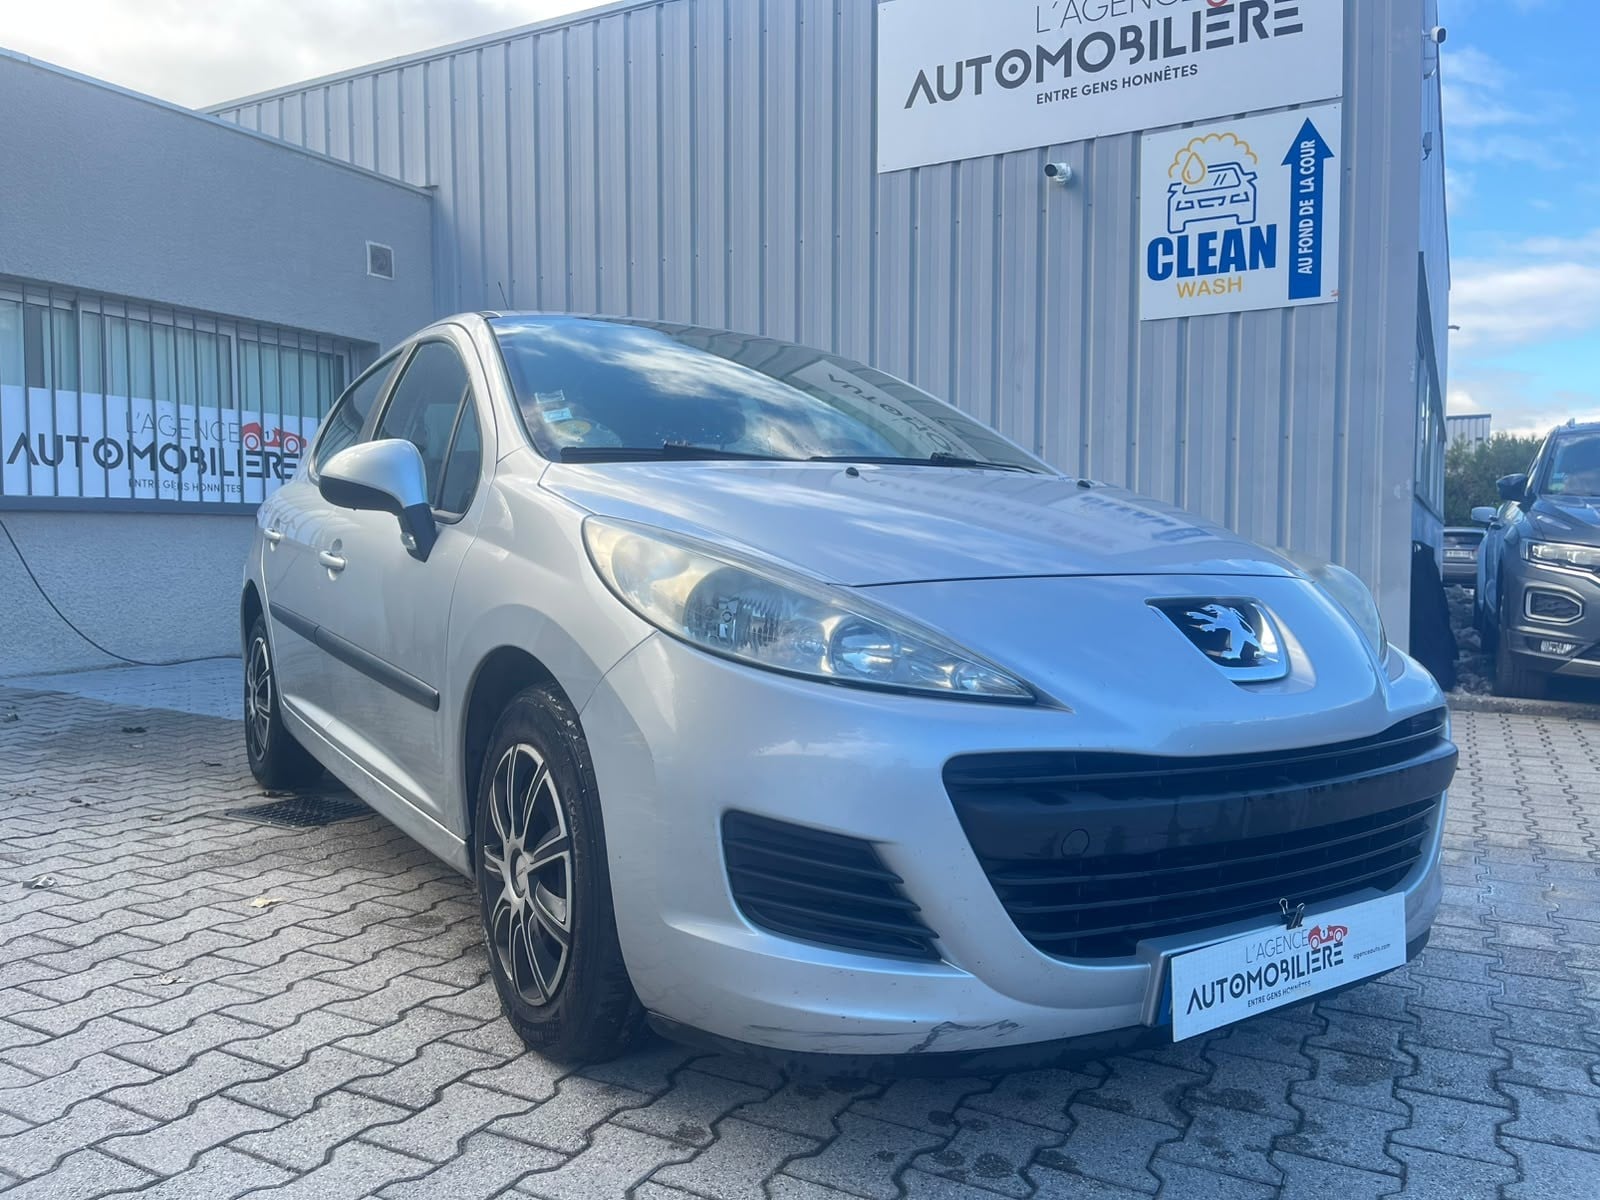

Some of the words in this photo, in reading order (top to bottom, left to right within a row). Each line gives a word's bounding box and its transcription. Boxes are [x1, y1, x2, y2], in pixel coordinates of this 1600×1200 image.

[1036, 87, 1078, 104] ENTRE
[1081, 79, 1118, 96] GENS
[1122, 64, 1198, 89] HONNÊTES
[1300, 139, 1316, 175] COUR
[1300, 177, 1315, 193] LA
[1299, 199, 1314, 216] DE
[1298, 218, 1314, 254] FOND
[1147, 224, 1277, 281] CLEAN
[1298, 257, 1313, 274] AU
[1177, 276, 1242, 298] WASH
[125, 411, 240, 443] L'AGENCE
[1246, 928, 1308, 963] L'AGENCE
[1247, 994, 1265, 1008] ENTRE
[1267, 989, 1282, 1001] GENS
